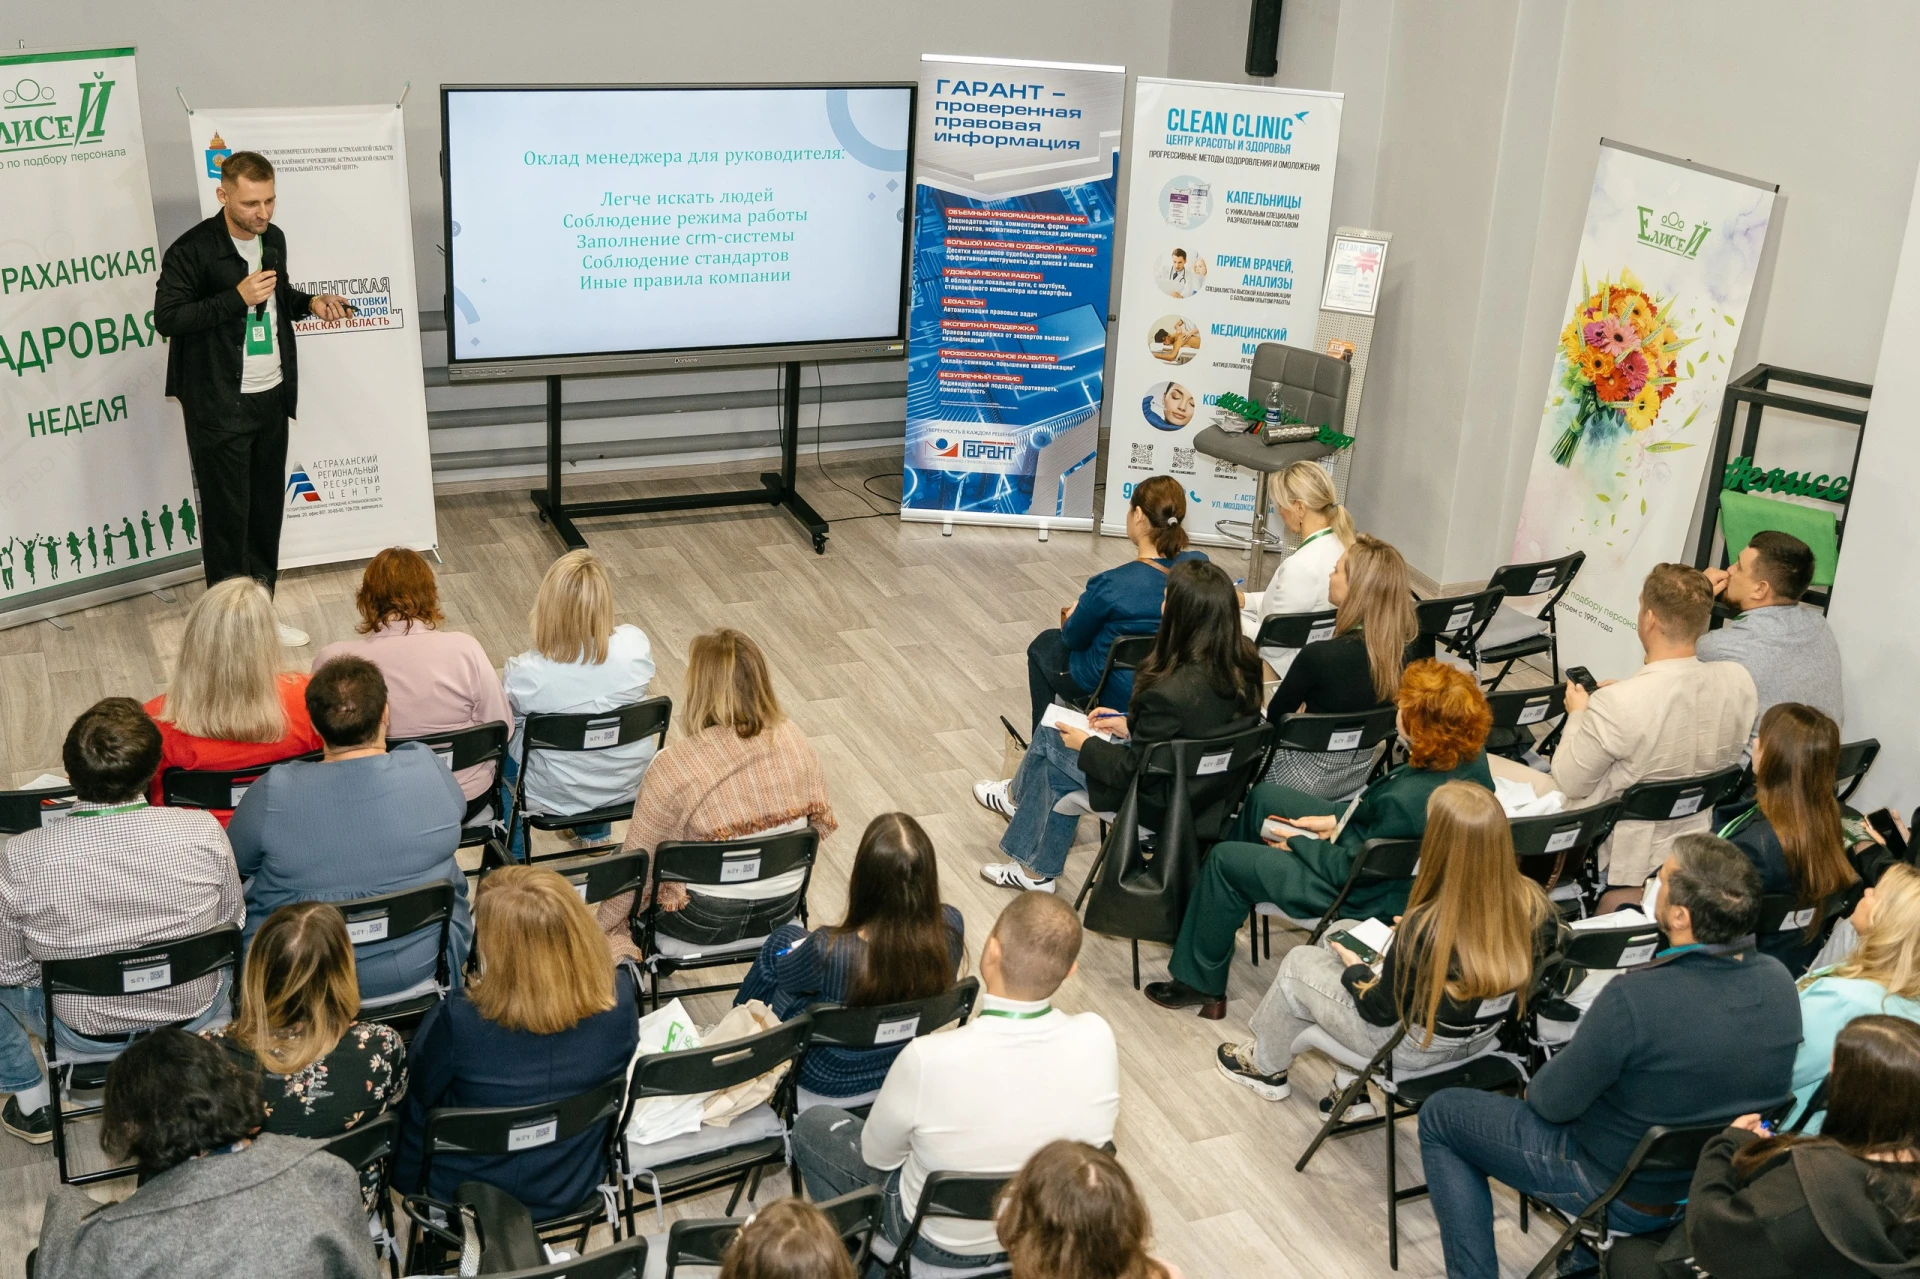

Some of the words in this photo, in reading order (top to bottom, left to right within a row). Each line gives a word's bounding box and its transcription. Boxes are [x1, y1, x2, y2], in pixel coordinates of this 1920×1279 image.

[936, 79, 1045, 100] ГАРАНТ
[935, 101, 1082, 119] проверенная
[935, 116, 1041, 132] правовая
[1167, 108, 1228, 135] CLEAN
[1232, 113, 1294, 141] CLINIC
[934, 131, 1081, 150] информация
[1166, 134, 1194, 146] ЦЕНТР
[1195, 137, 1236, 150] КРАСОТЫ
[1237, 140, 1244, 150] И
[1245, 141, 1291, 155] ЗДОРОВЬЯ
[7, 160, 20, 168] по
[24, 155, 67, 166] подбору
[71, 149, 126, 161] персонала
[524, 151, 580, 167] Оклад
[586, 152, 682, 167] менеджера
[688, 152, 719, 165] для
[725, 149, 845, 165] руководителя:
[1149, 150, 1198, 161] ПРОГРЕССИВНЫЕ
[1199, 154, 1225, 163] МЕТОДЫ
[1225, 156, 1272, 167] ОЗДОРОВЛЕНИЯ
[1278, 160, 1320, 172] ОМОЛОЖЕНИЯ
[600, 192, 651, 206] Легче
[657, 193, 714, 204] искать
[720, 188, 774, 204] людей
[1226, 190, 1302, 209] КАПЕЛЬНИЦЫ
[563, 213, 671, 229] Соблюдение
[677, 212, 742, 228] режима
[747, 208, 808, 226] работы
[948, 209, 990, 217] ОБЪЕМНЫЙ
[991, 211, 1065, 222] ИНФОРМАЦИОННЫЙ
[1227, 216, 1271, 227] РАЗРАБОТАННЫМ
[1272, 220, 1299, 229] СОСТАВОМ
[1230, 209, 1265, 218] УНИКАЛЬНЫМ
[1266, 211, 1300, 221] СПЕЦИАЛЬНО
[577, 234, 680, 249] Заполнение
[686, 231, 794, 245] crm-системы
[946, 239, 983, 247] БОЛЬШОЙ
[983, 241, 1015, 249] МАССИВ
[1016, 243, 1055, 251] СУДЕБНОЙ
[582, 254, 689, 269] Соблюдение
[695, 251, 789, 266] стандартов
[1217, 254, 1251, 269] ПРИЕМ
[1253, 258, 1294, 274] ВРАЧЕЙ,
[1, 246, 157, 294] РАХАНСКАЯ
[946, 268, 981, 276] УДОБНЫЙ
[289, 277, 390, 296] ИДЕНТСКАЯ
[580, 276, 627, 289] Иные
[633, 275, 703, 290] правила
[709, 271, 791, 285] компании
[1242, 274, 1293, 290] АНАЛИЗЫ
[348, 296, 388, 307] ОТОВКИ
[352, 306, 389, 317] АДРОВ
[294, 320, 341, 332] ХАНСКАЯ
[345, 317, 390, 328] ОБЛАСТЬ
[943, 321, 989, 329] ЭКСПЕРТНАЯ
[990, 324, 1035, 332] ПОДДЕРЖКА
[1211, 323, 1287, 341] МЕДИЦИНСКИЙ
[941, 350, 1016, 359] ПРОФЕССИОНАЛЬНОЕ
[1017, 354, 1055, 362] РАЗВИТИЕ
[940, 371, 991, 380] БЕЗУПРЕЧНЫЙ
[28, 395, 128, 437] НЕДЕЛЯ
[313, 454, 378, 469] АСТРАХАНСКИЙ
[318, 464, 379, 479] РЕГИОНАЛЬНЫЙ
[323, 474, 380, 489] РЕСУРСНЫЙ
[329, 486, 381, 499] ЦЕНТР
[1223, 502, 1255, 511] МОЗДОКСК
[1547, 593, 1578, 614] Ротаем
[1584, 612, 1598, 623] 1997
[1598, 620, 1613, 633] года
[1570, 591, 1604, 613] подбору
[1603, 607, 1638, 630] персона
